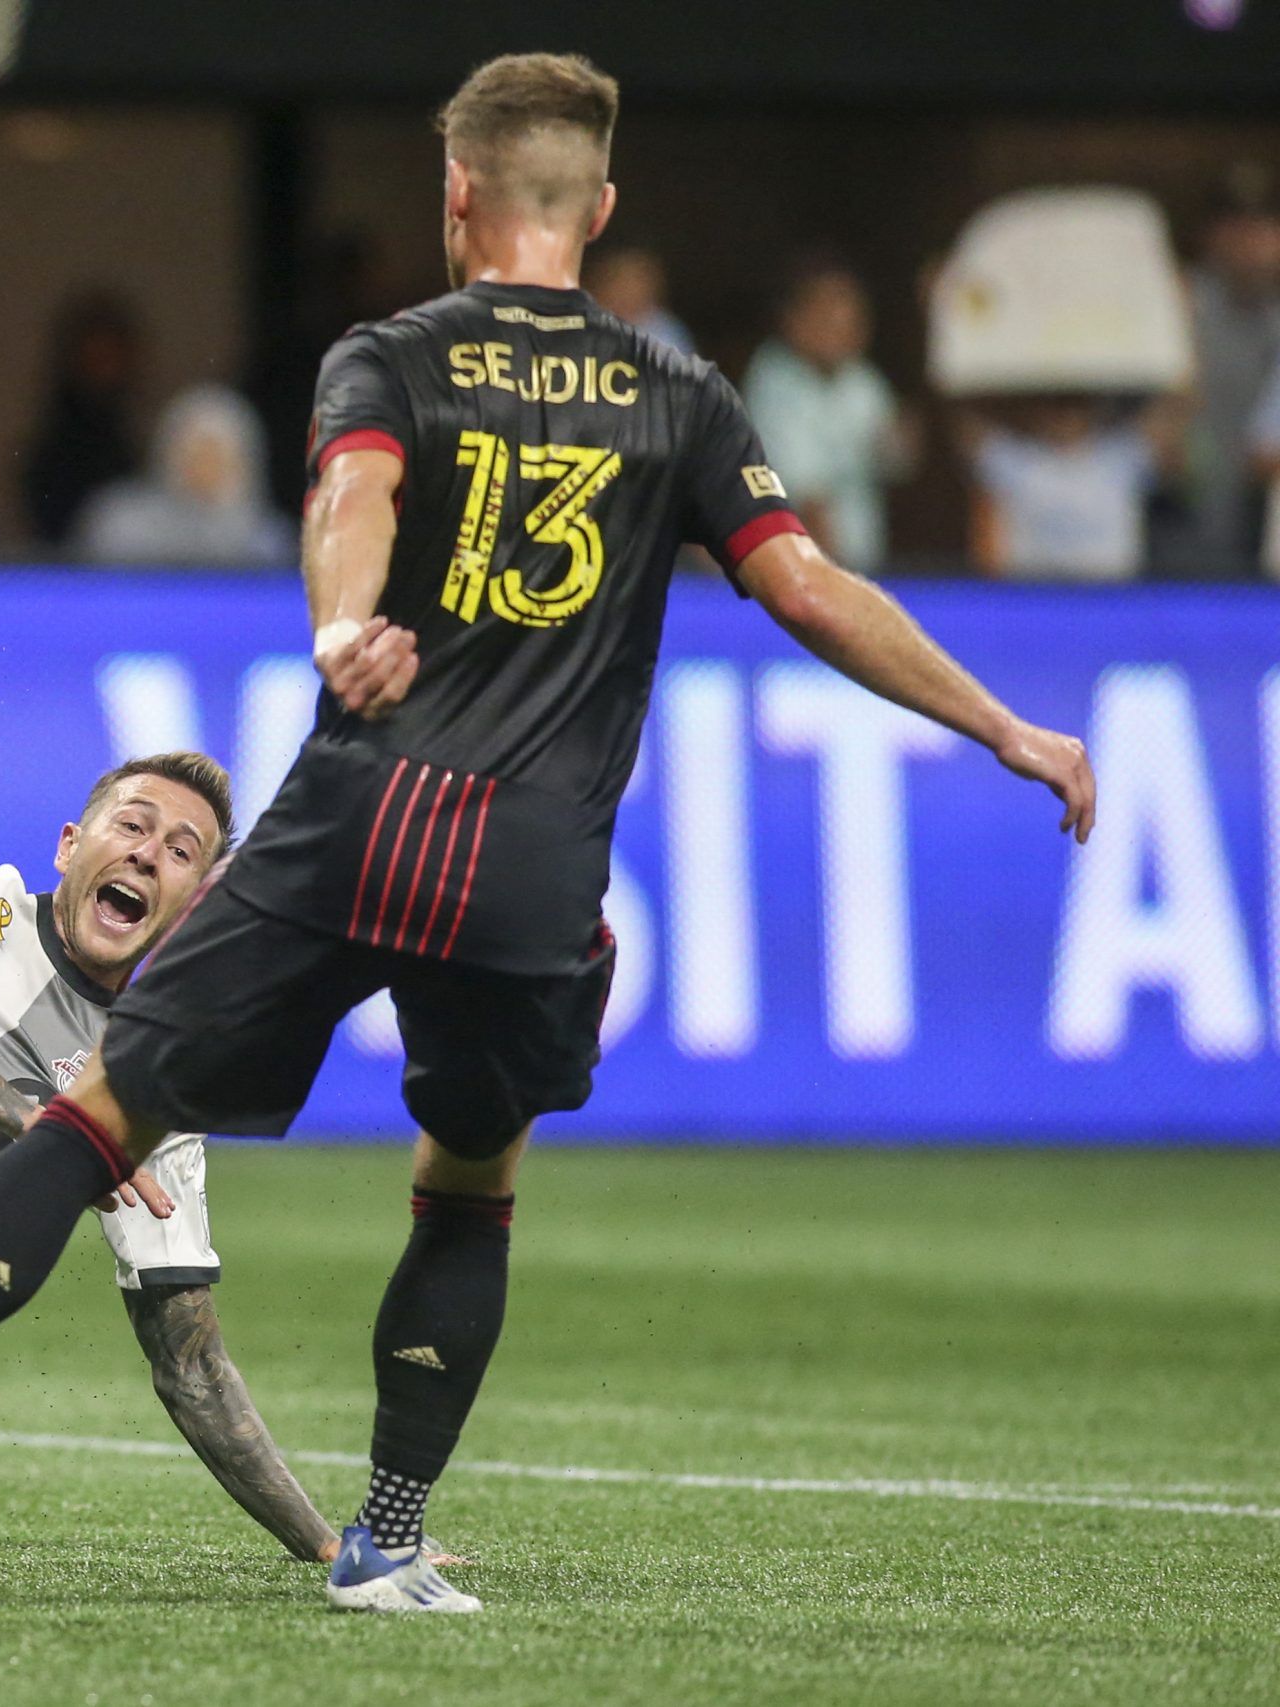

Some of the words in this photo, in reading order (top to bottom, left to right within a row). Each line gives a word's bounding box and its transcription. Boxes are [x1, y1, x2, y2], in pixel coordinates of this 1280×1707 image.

[449, 341, 639, 407] SEJDIC
[440, 429, 622, 628] 13
[1043, 662, 1280, 1064] A
